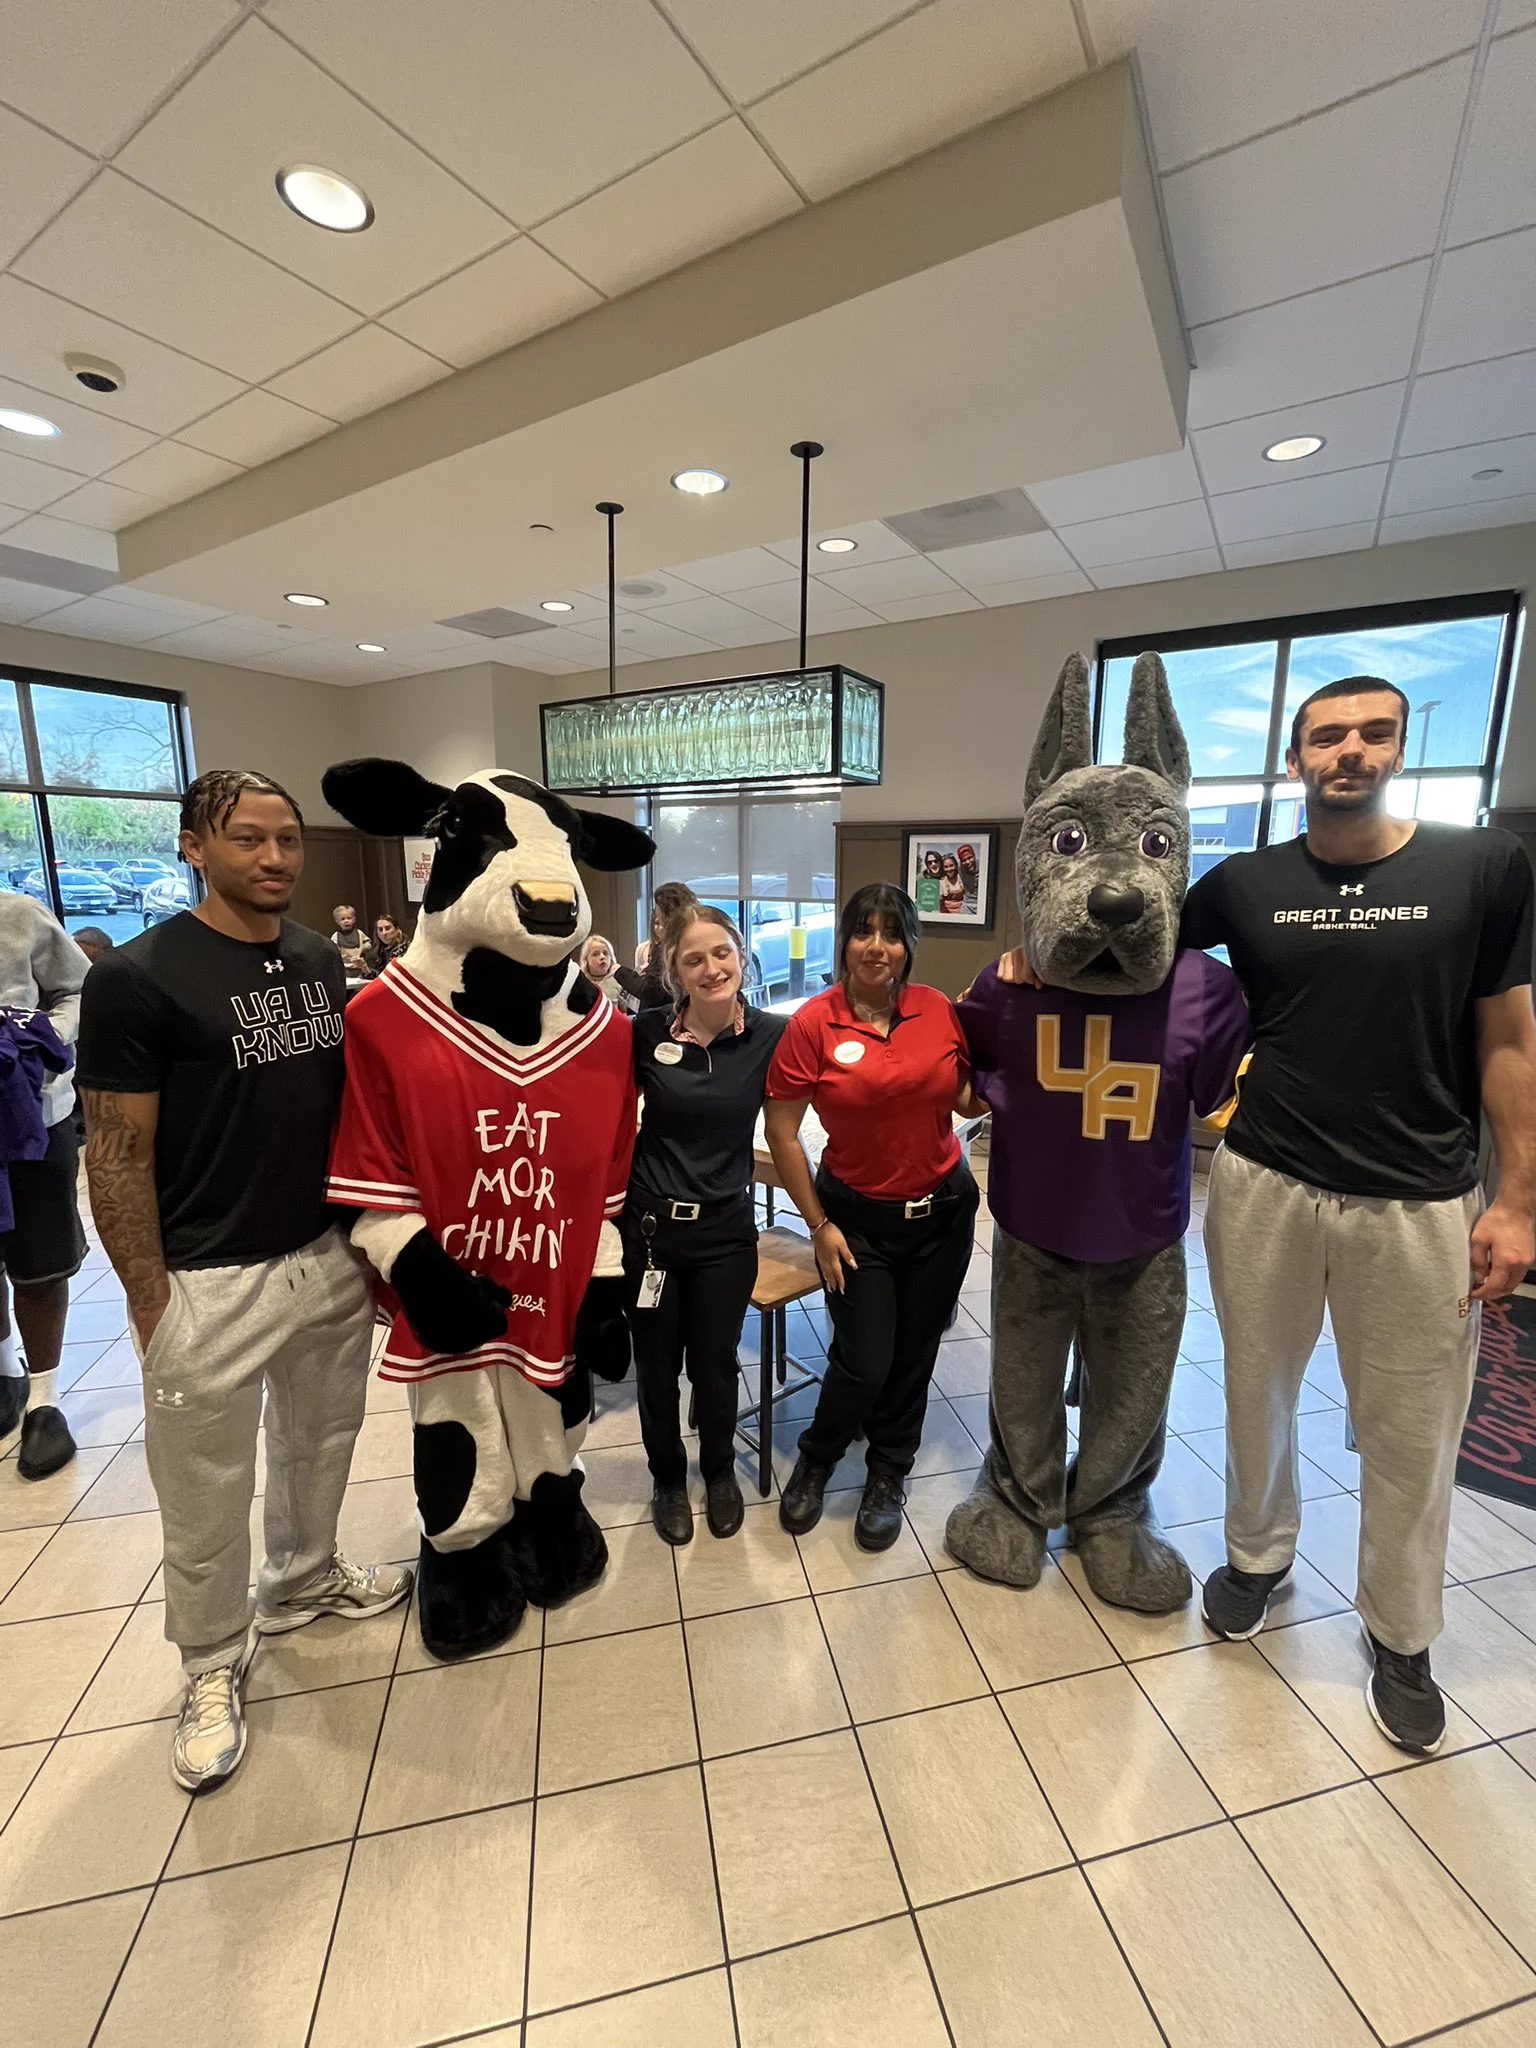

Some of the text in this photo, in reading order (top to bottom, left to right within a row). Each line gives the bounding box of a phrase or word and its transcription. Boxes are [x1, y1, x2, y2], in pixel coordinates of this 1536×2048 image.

[1273, 905, 1429, 924] GREAT DANES
[1312, 922, 1378, 931] BASKETBALL
[230, 981, 331, 1029] UA U
[231, 1013, 344, 1070] KNOW
[1036, 1014, 1161, 1141] UA
[474, 1101, 562, 1156] EAT
[467, 1156, 556, 1211] MOR
